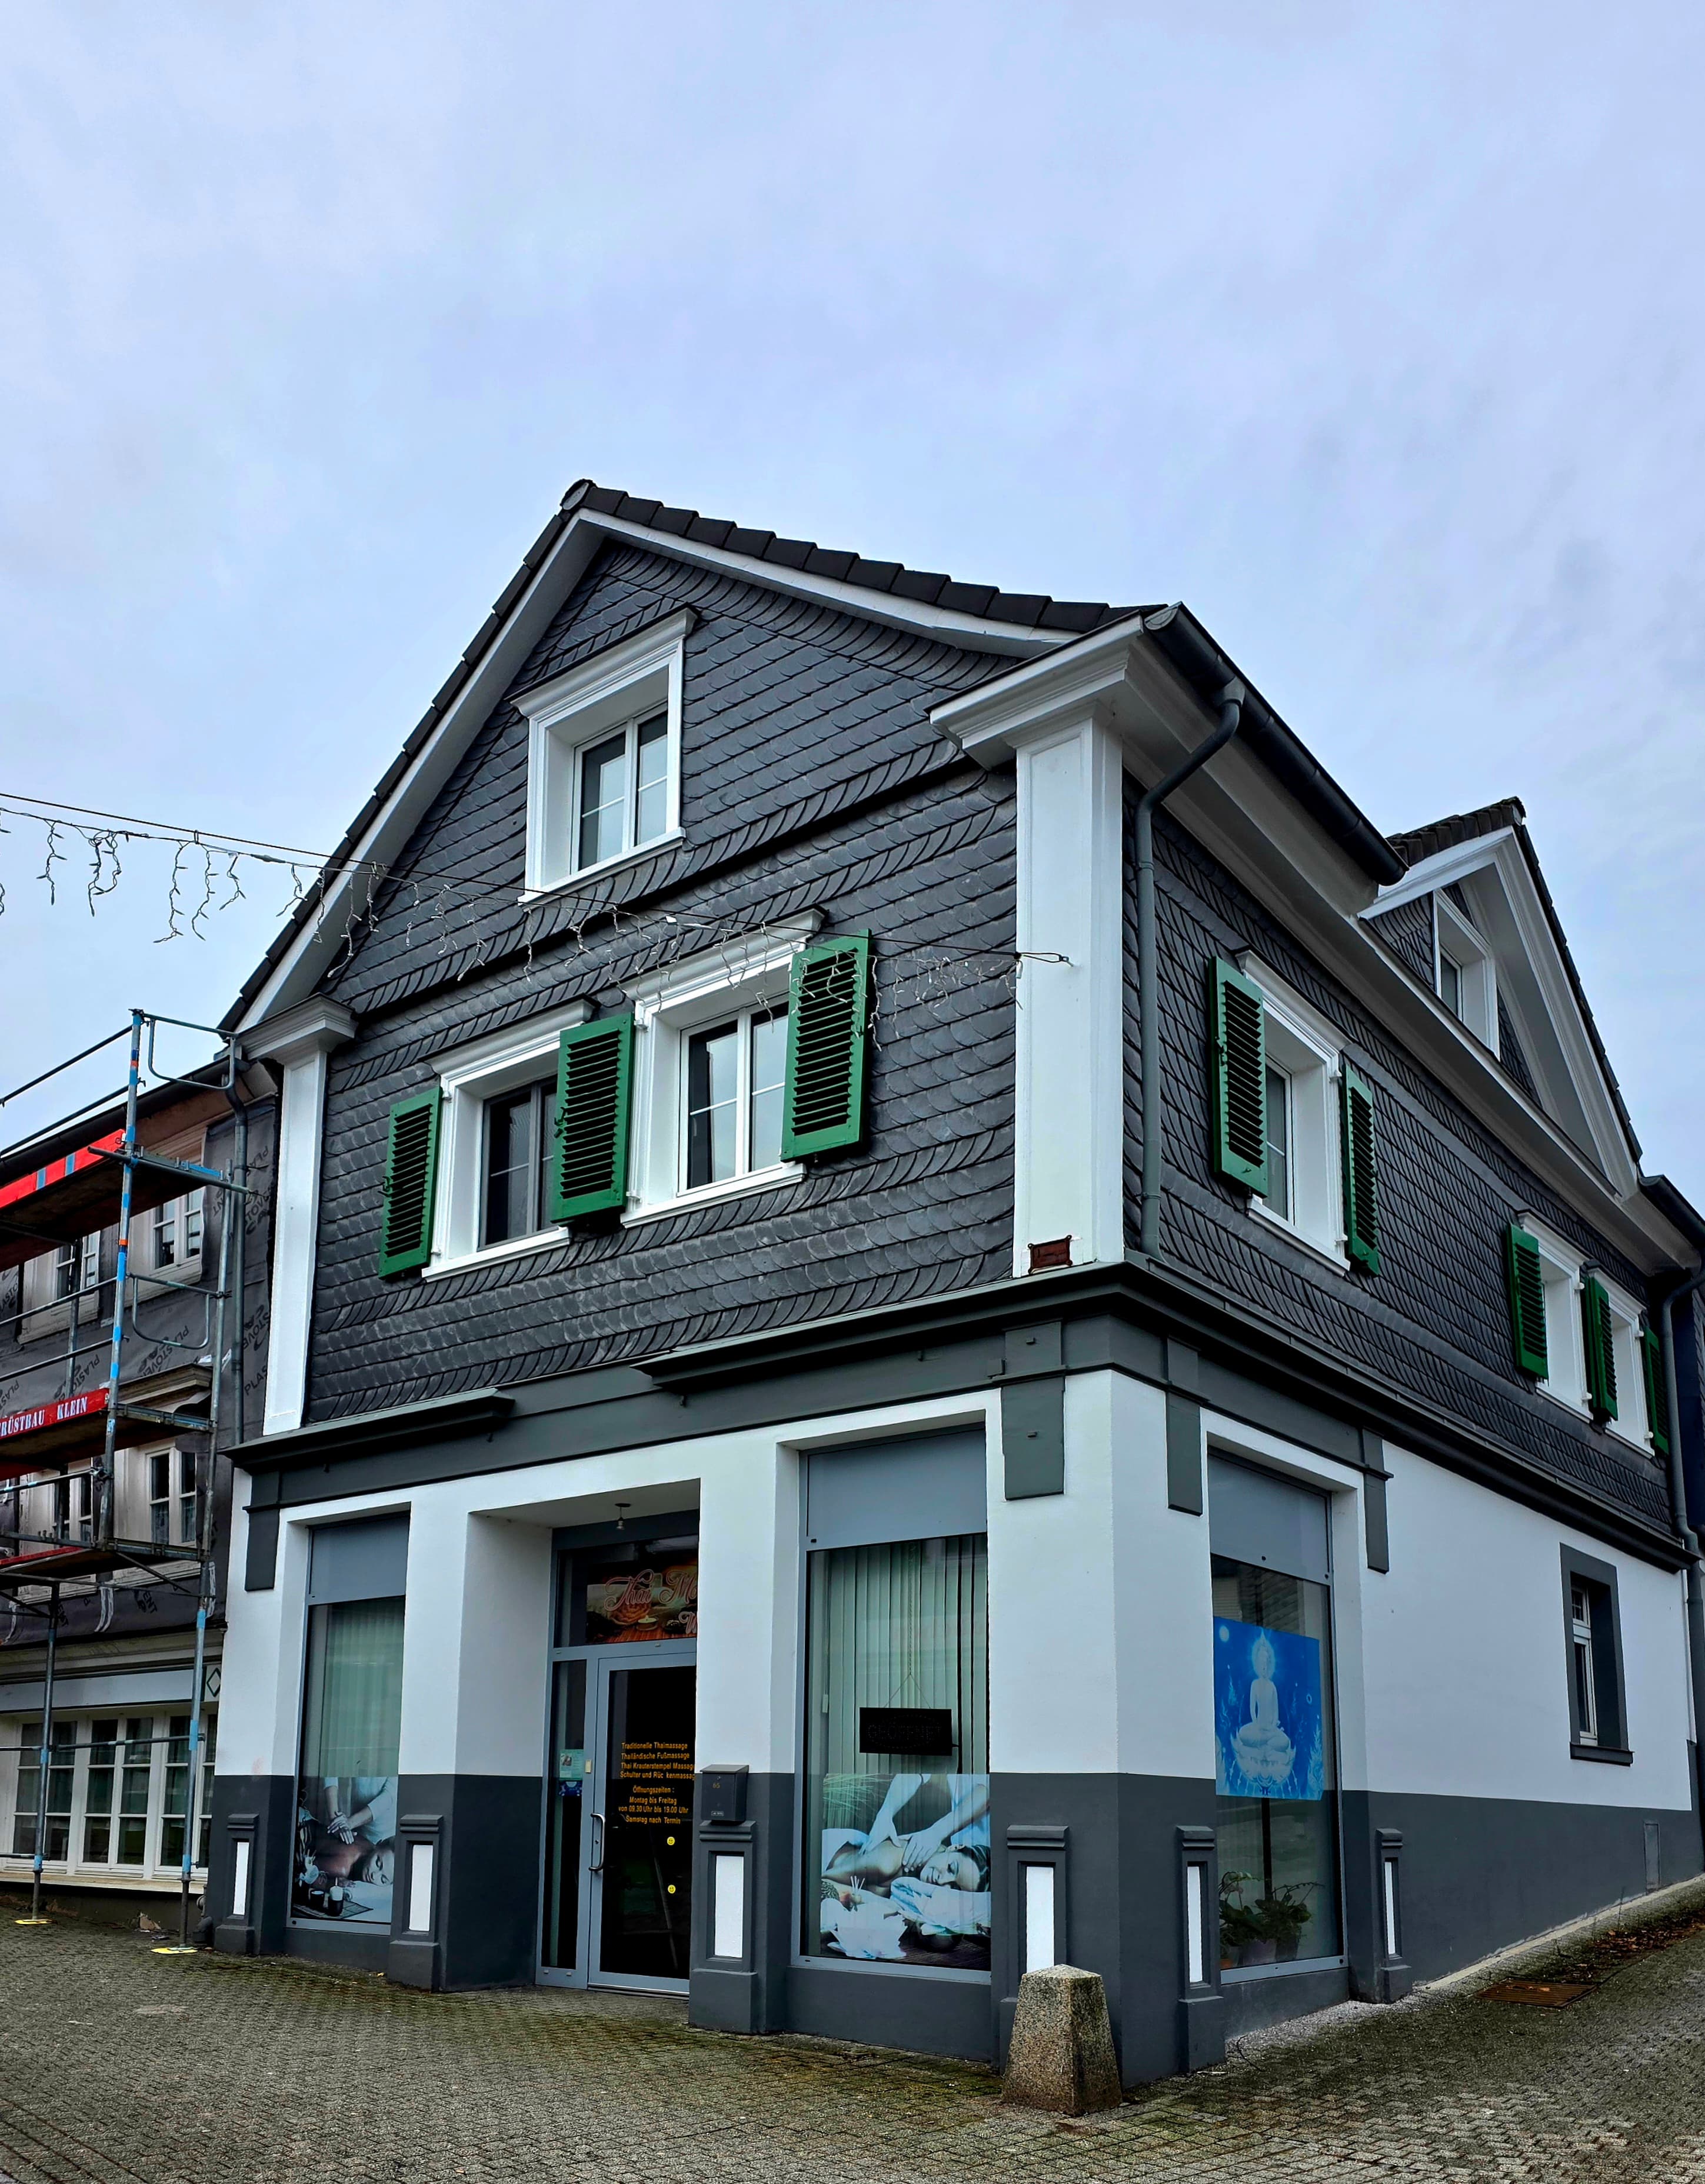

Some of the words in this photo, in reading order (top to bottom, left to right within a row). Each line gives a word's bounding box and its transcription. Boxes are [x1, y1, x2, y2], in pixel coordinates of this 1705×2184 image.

[0, 1409, 45, 1436] RÜSTBAU
[56, 1396, 88, 1420] KLEIN
[604, 1569, 655, 1611] Thai
[654, 1742, 688, 1750] Thaimassage
[657, 1752, 690, 1760] Fußmassage
[632, 1785, 671, 1795] Öffnungszeiten
[629, 1796, 648, 1805] Montag
[658, 1797, 677, 1806] Freitag
[625, 1815, 648, 1825] Samstag
[664, 1816, 681, 1825] Termin
